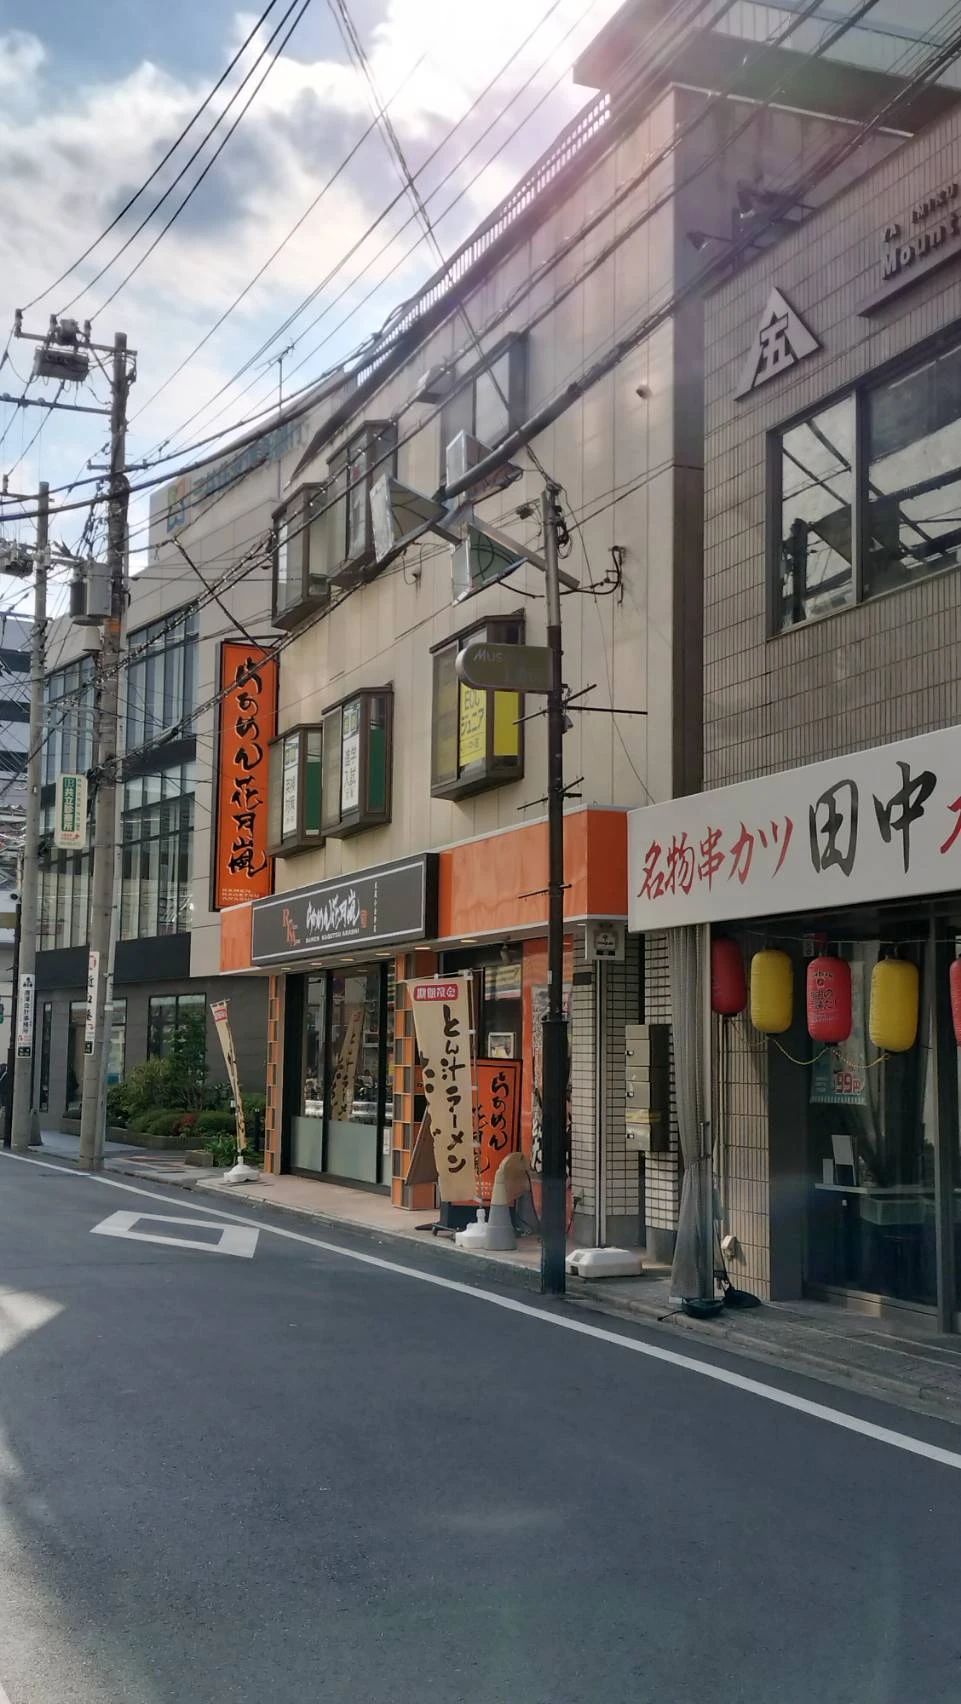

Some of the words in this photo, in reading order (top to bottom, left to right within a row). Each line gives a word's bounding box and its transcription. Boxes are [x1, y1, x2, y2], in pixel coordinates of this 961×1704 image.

[637, 815, 793, 900] 名物串カツ
[808, 760, 937, 877] 田中
[440, 1003, 466, 1173] とん汁ラーメン
[488, 1071, 510, 1150] らあめん
